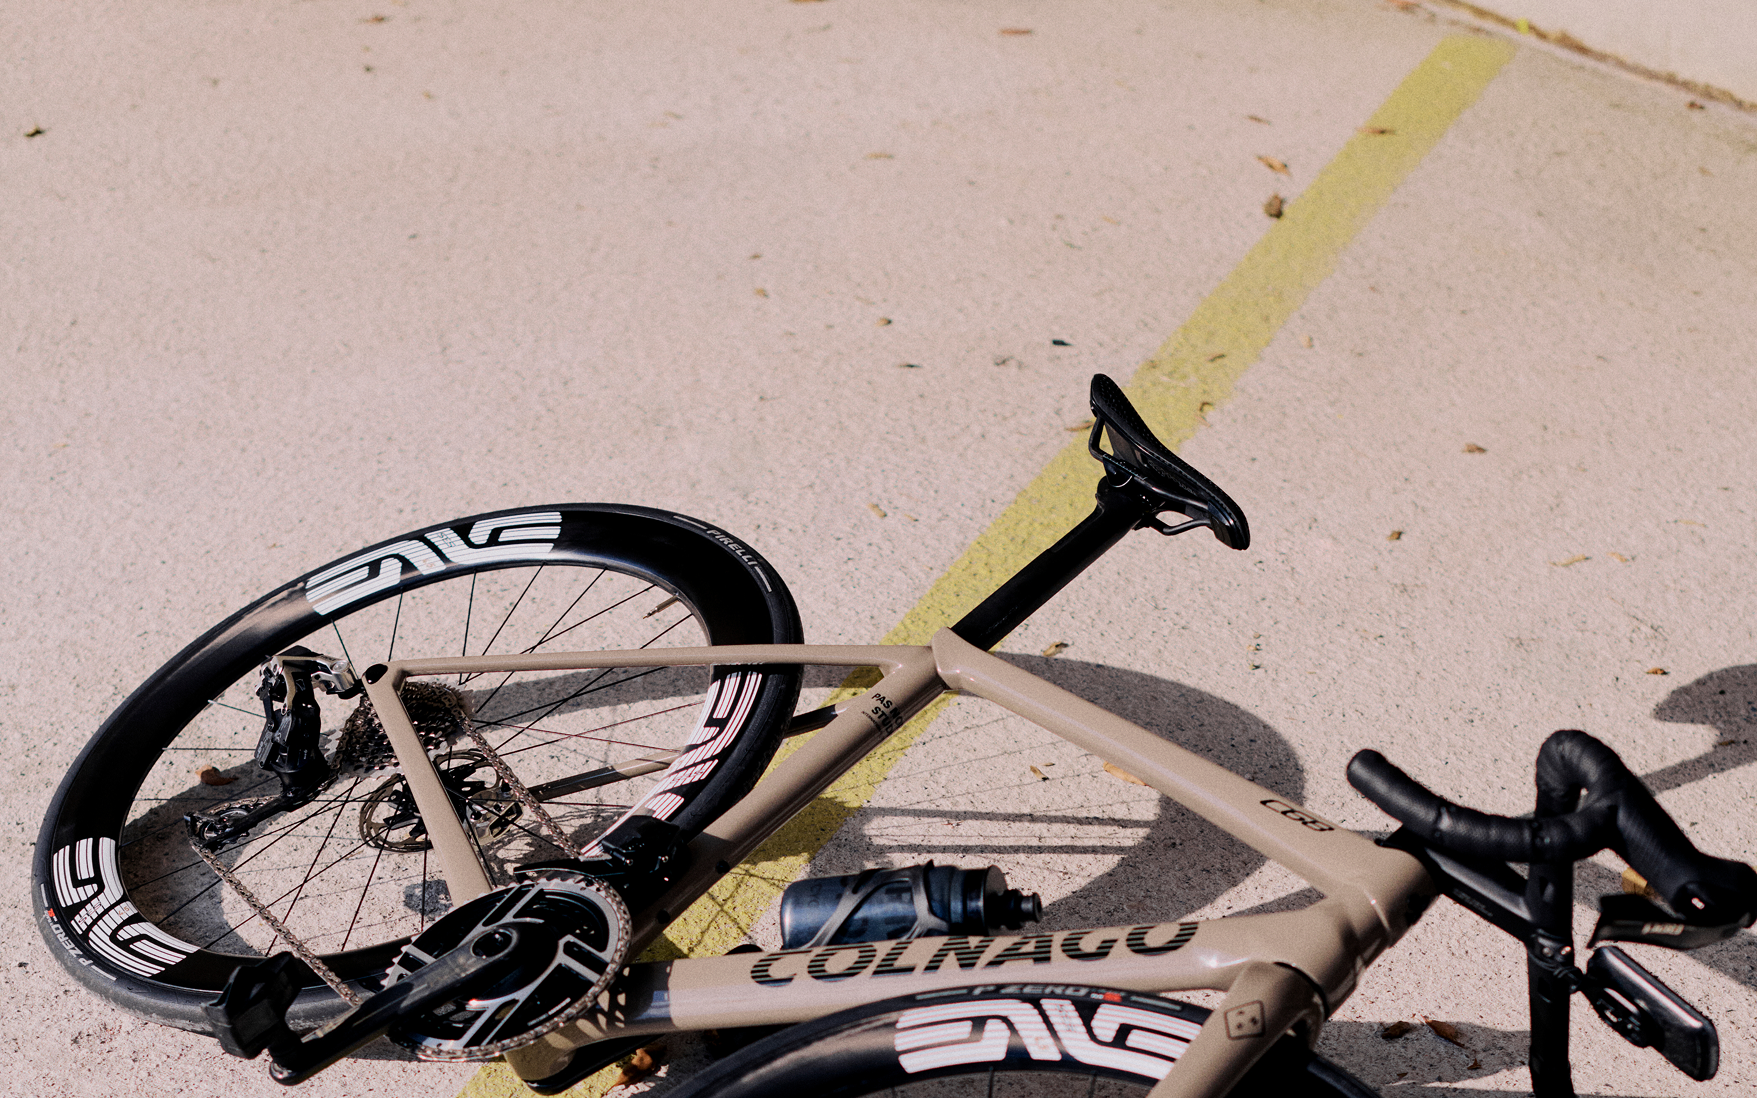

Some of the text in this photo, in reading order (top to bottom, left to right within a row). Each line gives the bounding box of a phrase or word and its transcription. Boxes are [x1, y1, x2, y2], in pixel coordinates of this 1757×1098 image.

[706, 529, 758, 566] PIRELLI
[871, 692, 893, 709] PAS
[871, 706, 896, 736] STUD
[50, 921, 84, 958] ZERO
[78, 957, 94, 967] P
[750, 922, 1199, 988] COLNAGO
[999, 983, 1090, 997] ZERO
